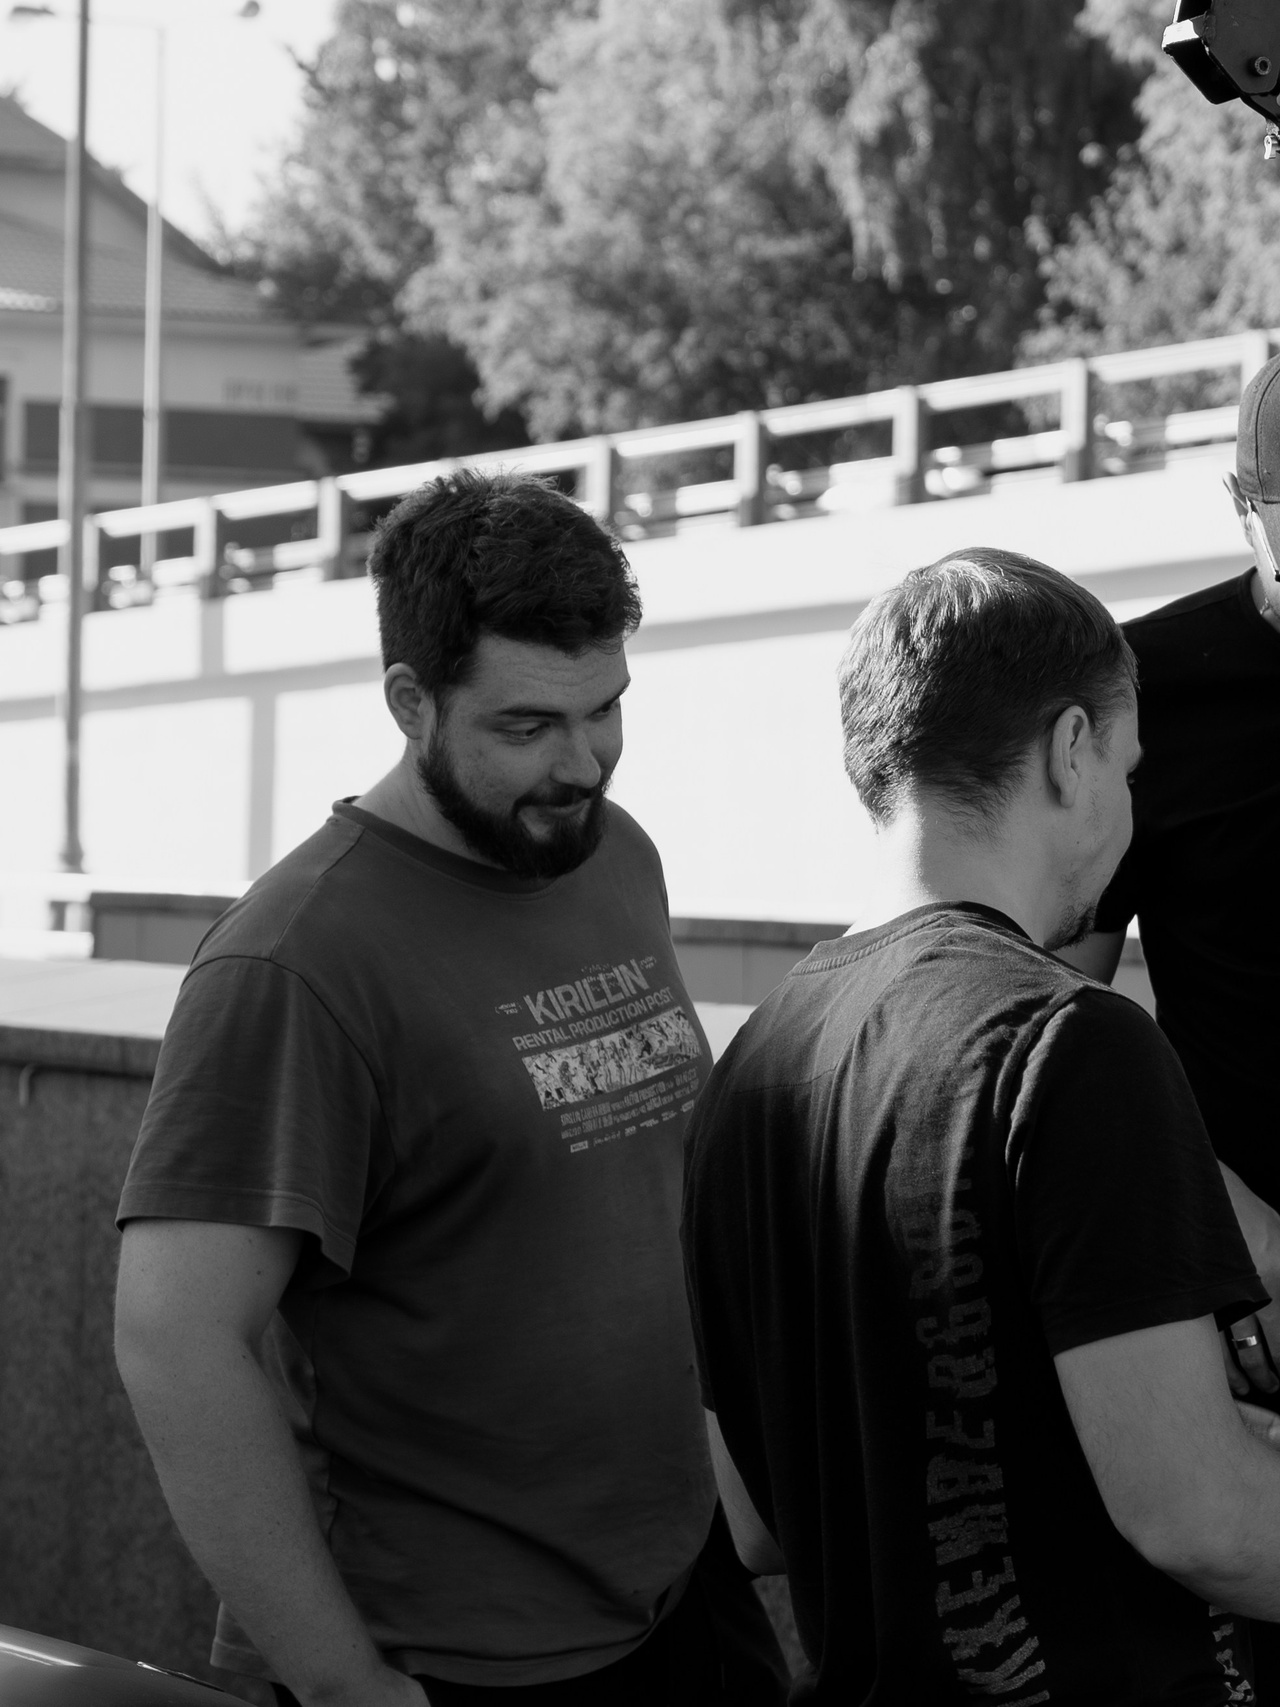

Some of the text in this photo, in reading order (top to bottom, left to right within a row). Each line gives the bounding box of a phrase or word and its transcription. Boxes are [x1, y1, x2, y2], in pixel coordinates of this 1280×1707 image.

[512, 987, 675, 1051] RENTAL PRODUCTION POST
[523, 959, 650, 1025] KIRILLIN
